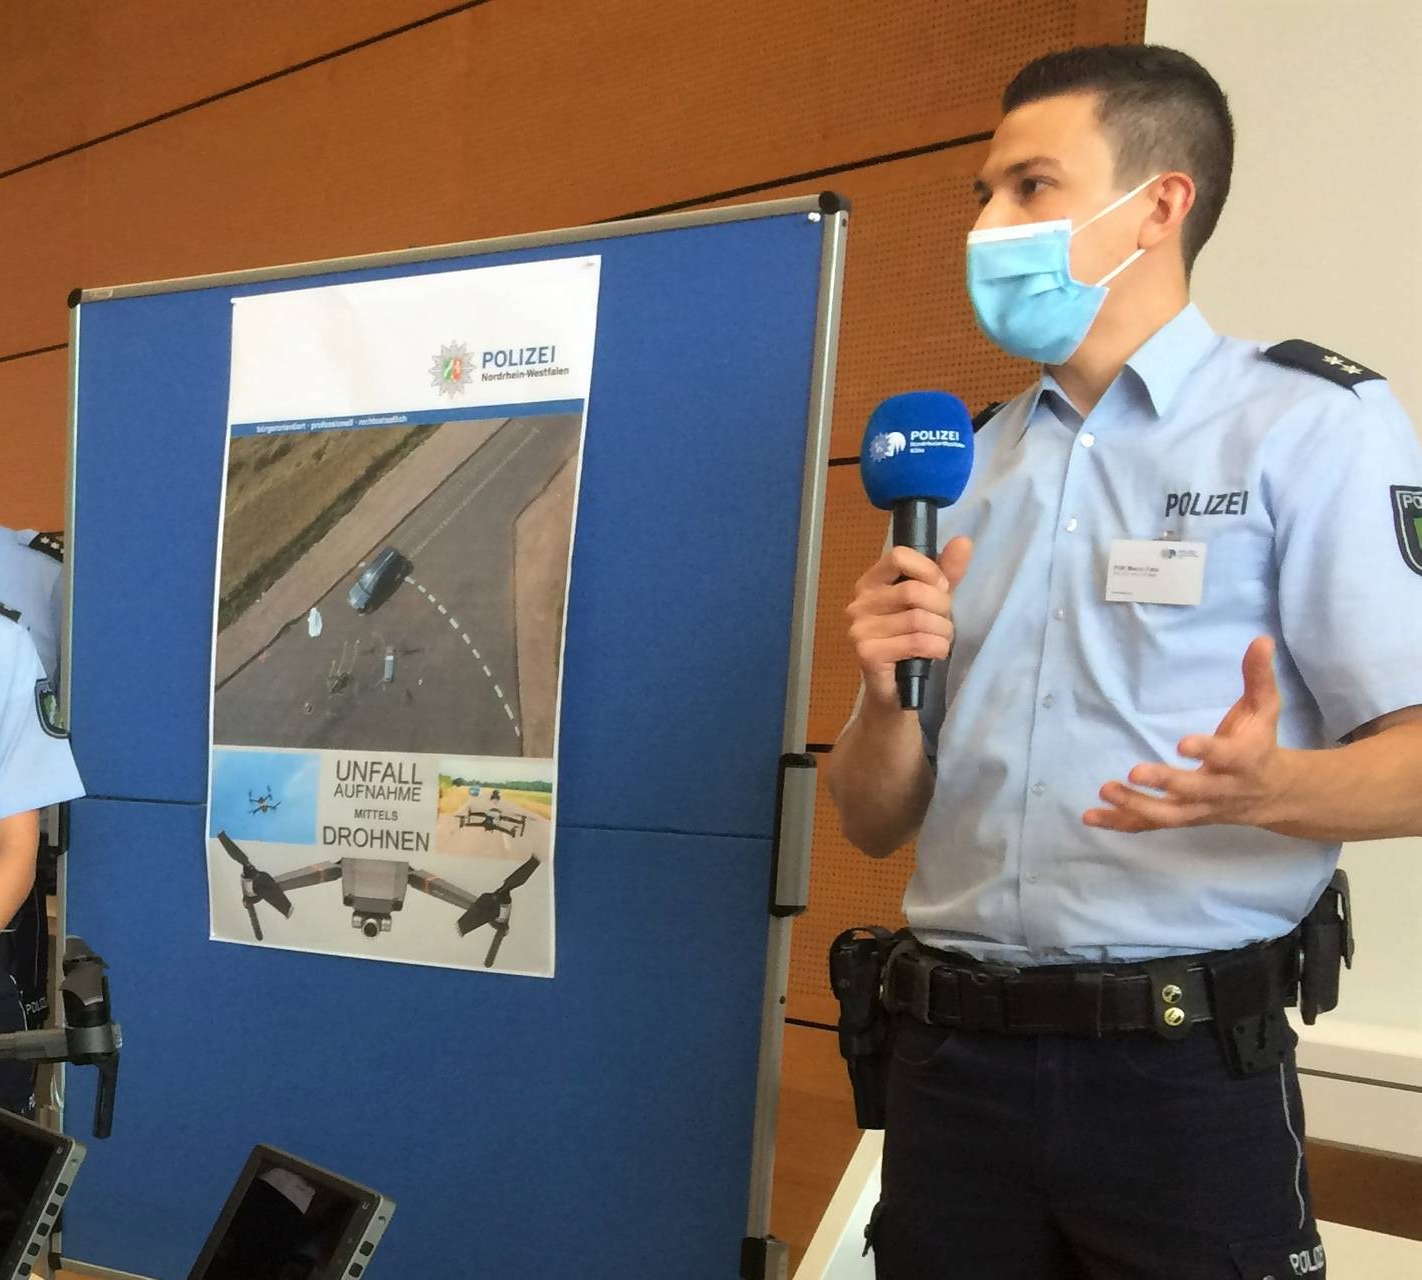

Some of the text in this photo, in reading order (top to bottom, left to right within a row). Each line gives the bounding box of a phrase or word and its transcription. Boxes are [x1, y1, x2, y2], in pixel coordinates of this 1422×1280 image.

[482, 345, 556, 369] POLIZEI
[481, 367, 570, 382] Nordrhein-Westfalen
[910, 430, 960, 441] POLIZEI
[1165, 490, 1249, 518] POLIZEI
[336, 759, 423, 785] UNFALL
[334, 783, 422, 802] AUFNAHME
[354, 808, 399, 821] MITTELS
[322, 826, 430, 852] DROHNEN
